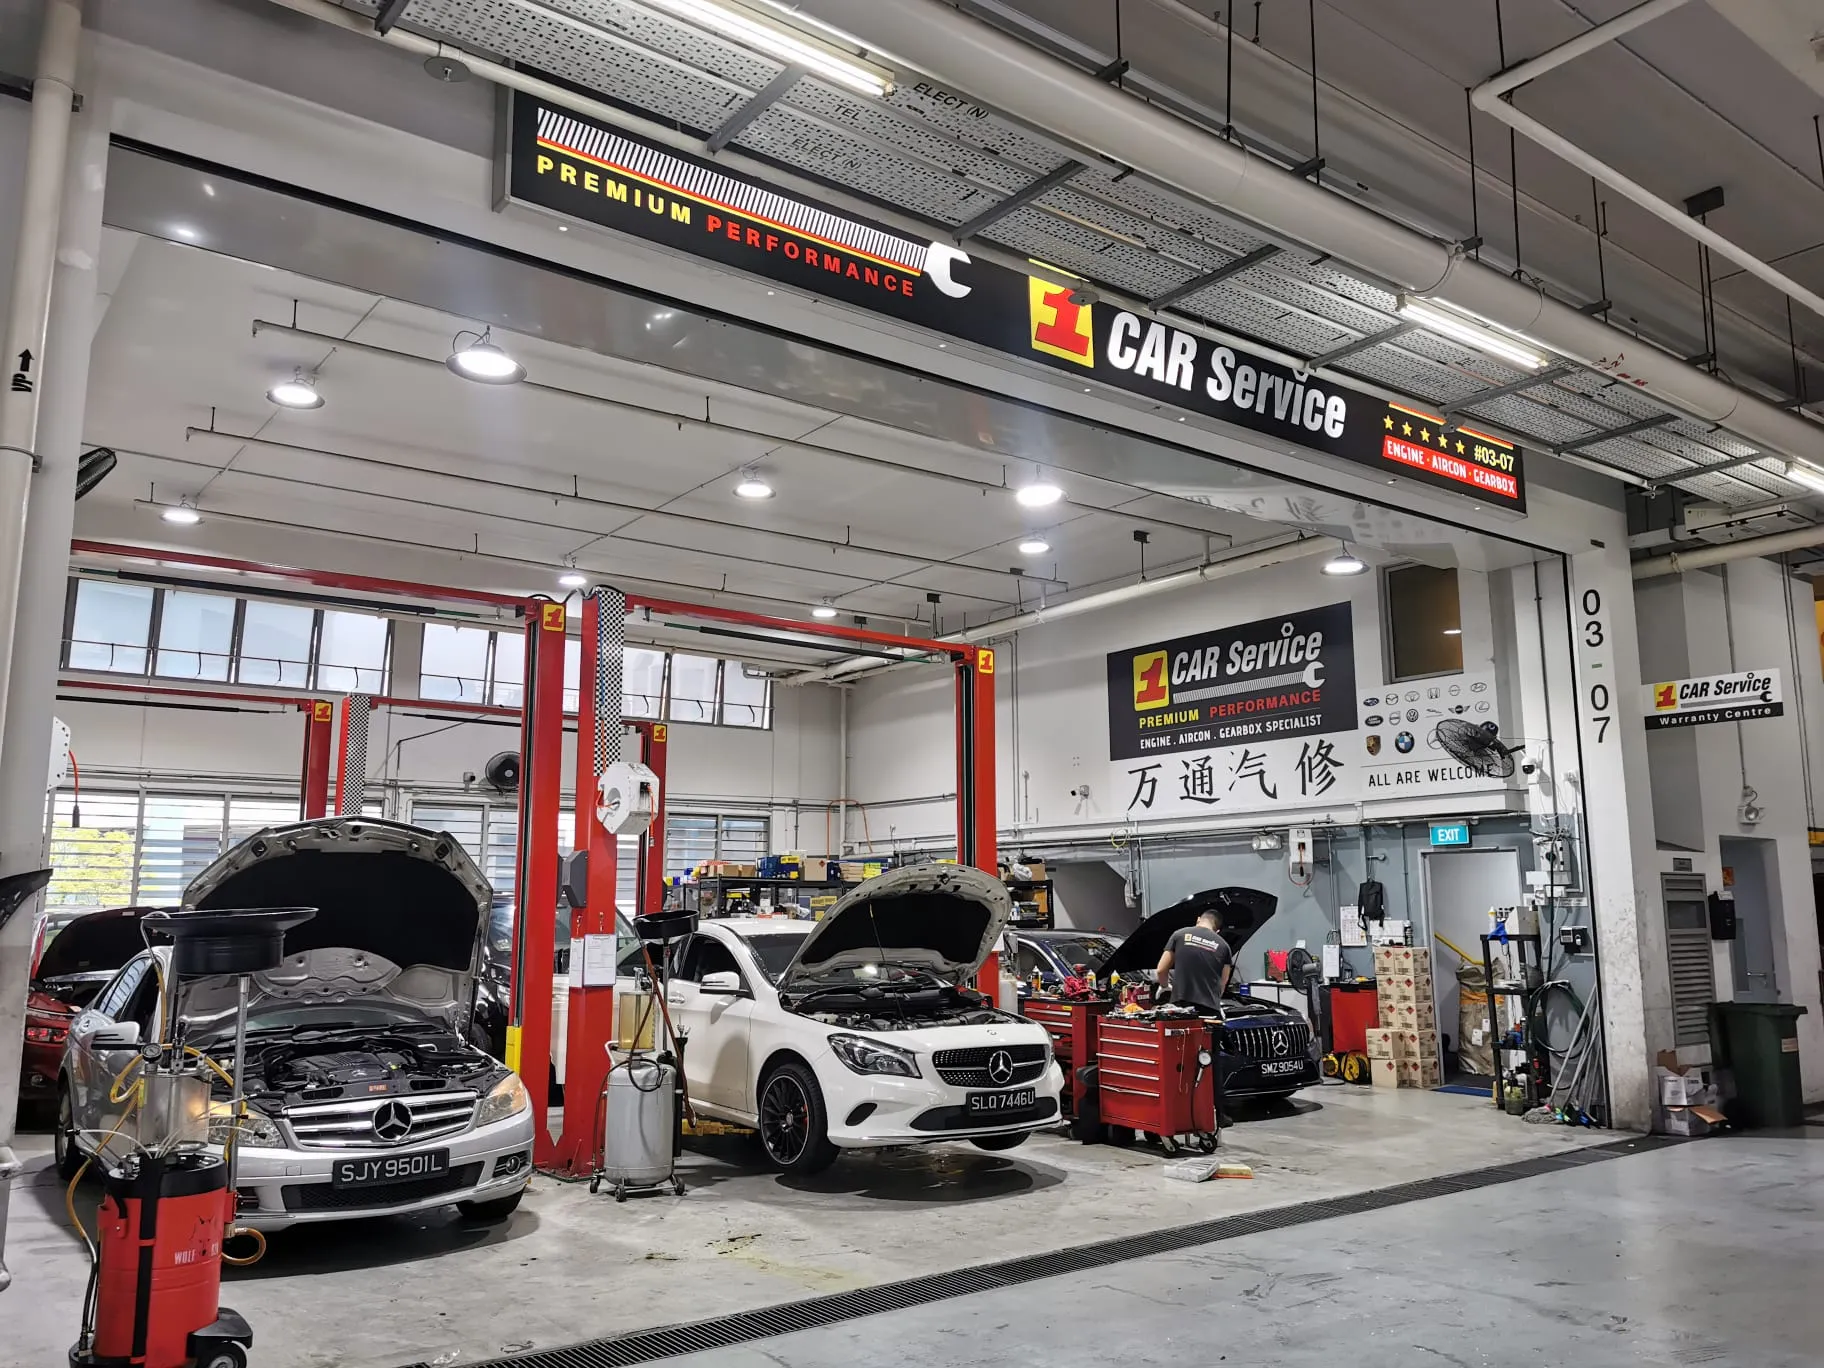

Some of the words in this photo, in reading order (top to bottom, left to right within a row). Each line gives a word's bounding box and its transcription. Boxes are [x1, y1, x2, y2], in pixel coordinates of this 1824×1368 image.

[835, 103, 862, 122] TEL
[914, 81, 967, 112] ELECT
[967, 103, 989, 120] (N)
[791, 138, 841, 163] ELECT
[537, 155, 692, 225] PREMIUM
[706, 214, 914, 297] PERFORMANCE
[1035, 286, 1089, 357] 1
[1107, 311, 1197, 391] CAR
[1206, 348, 1346, 439] Service
[1386, 440, 1425, 465] ENGINE
[1431, 455, 1467, 479] AIRCON
[1473, 468, 1516, 494] GEARBOX
[1474, 444, 1514, 472] #03-07
[545, 608, 563, 629] 1
[980, 654, 992, 670] 1
[1136, 656, 1167, 704] 1
[1171, 645, 1221, 686] CAR
[1225, 622, 1323, 676] Service
[1656, 685, 1676, 708] 1
[1679, 682, 1709, 700] CAR
[1713, 672, 1771, 696] Service
[315, 705, 330, 720] 1
[1139, 708, 1199, 729] PREMIUM
[1209, 689, 1321, 719] PERFORMANCE
[1659, 710, 1719, 726] Warranty
[1725, 706, 1772, 719] Centre
[654, 727, 666, 741] 1
[1139, 734, 1172, 750] ENGINE
[1178, 730, 1211, 746] AIRCON
[1219, 722, 1263, 740] GEARBOX
[1265, 714, 1322, 732] SPECIALIST
[1127, 738, 1345, 812] 万通汽修
[1368, 773, 1391, 788] ALL
[1396, 770, 1421, 785] ARE
[1428, 764, 1493, 782] WELCOME
[1437, 828, 1460, 842] EXIT
